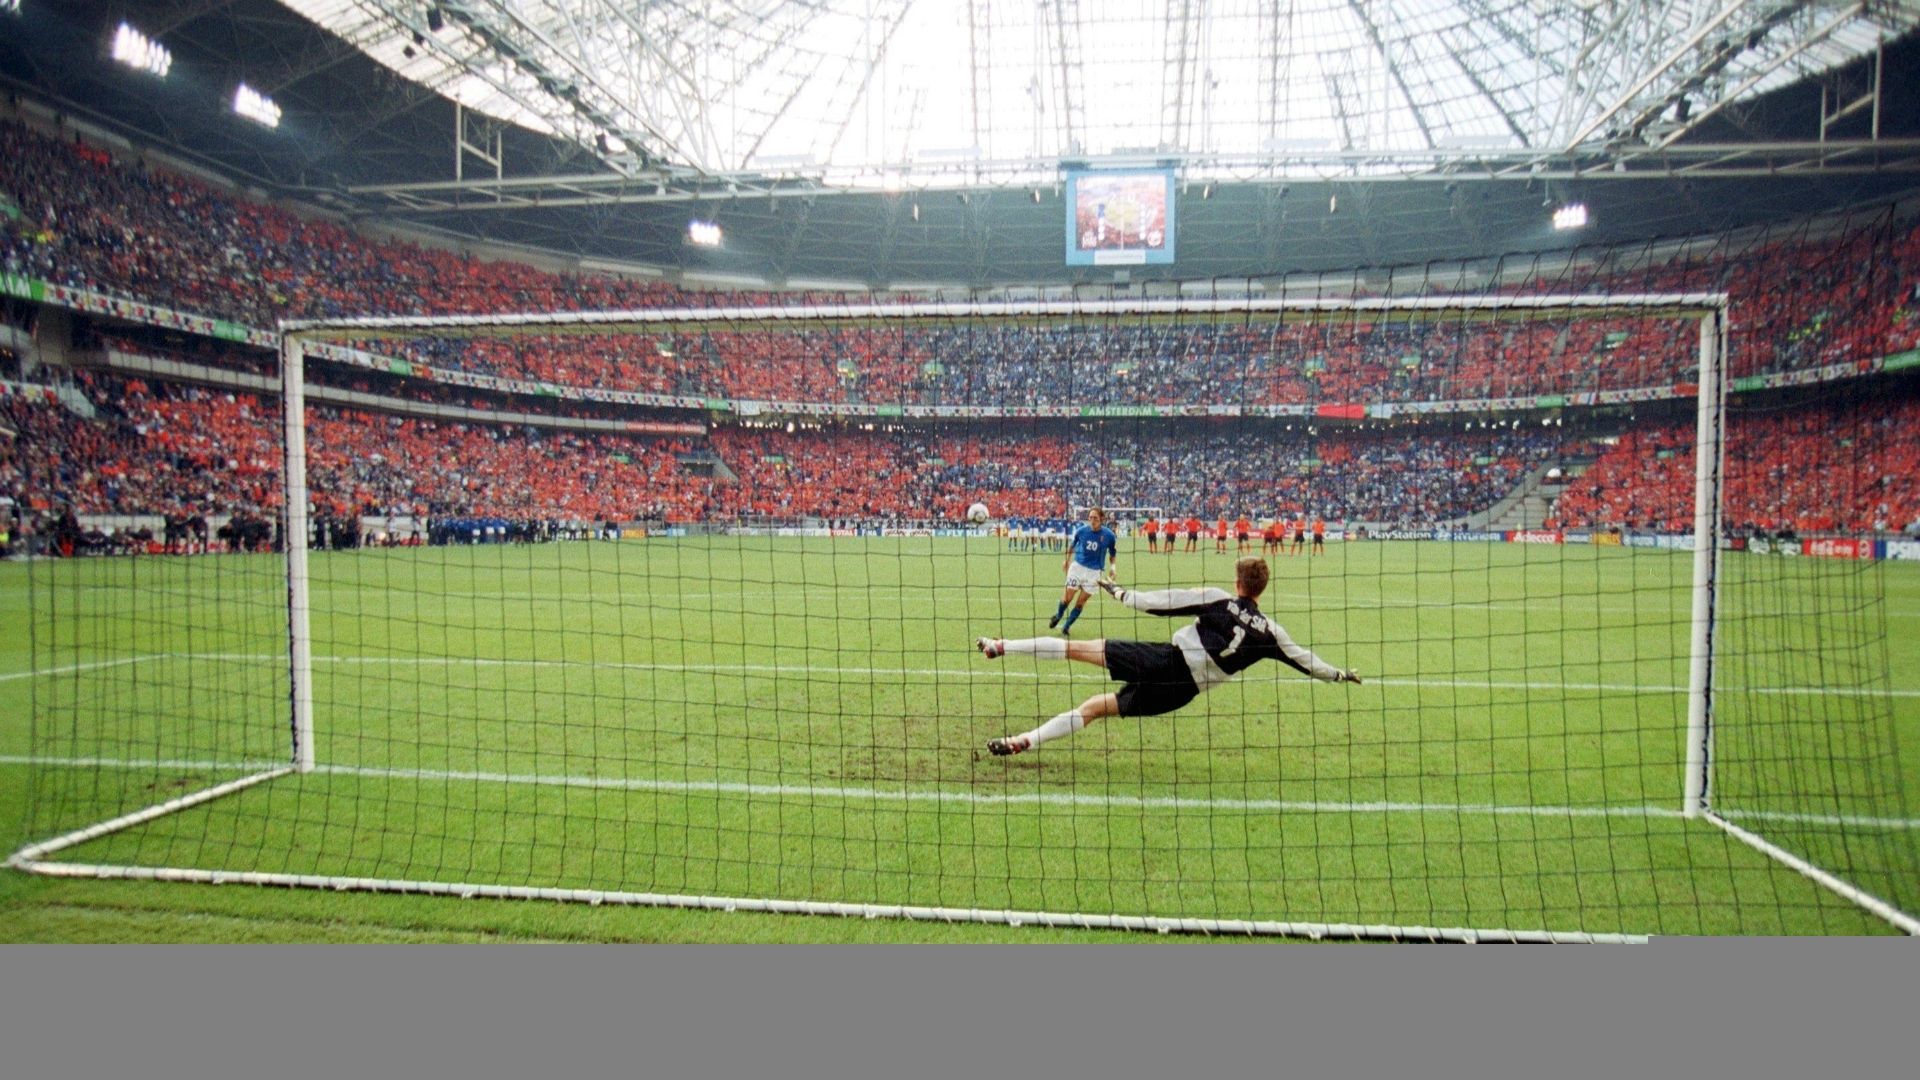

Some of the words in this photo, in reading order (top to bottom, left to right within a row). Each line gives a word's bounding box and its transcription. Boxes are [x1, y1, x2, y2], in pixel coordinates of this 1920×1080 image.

[1088, 406, 1152, 416] AMSTERDAM
[832, 529, 854, 537] TOTAL
[966, 529, 988, 537] KLM
[1368, 530, 1431, 540] PlayStation
[1513, 531, 1556, 543] Adecco
[1086, 541, 1098, 551] 20
[1219, 625, 1246, 658] 1
